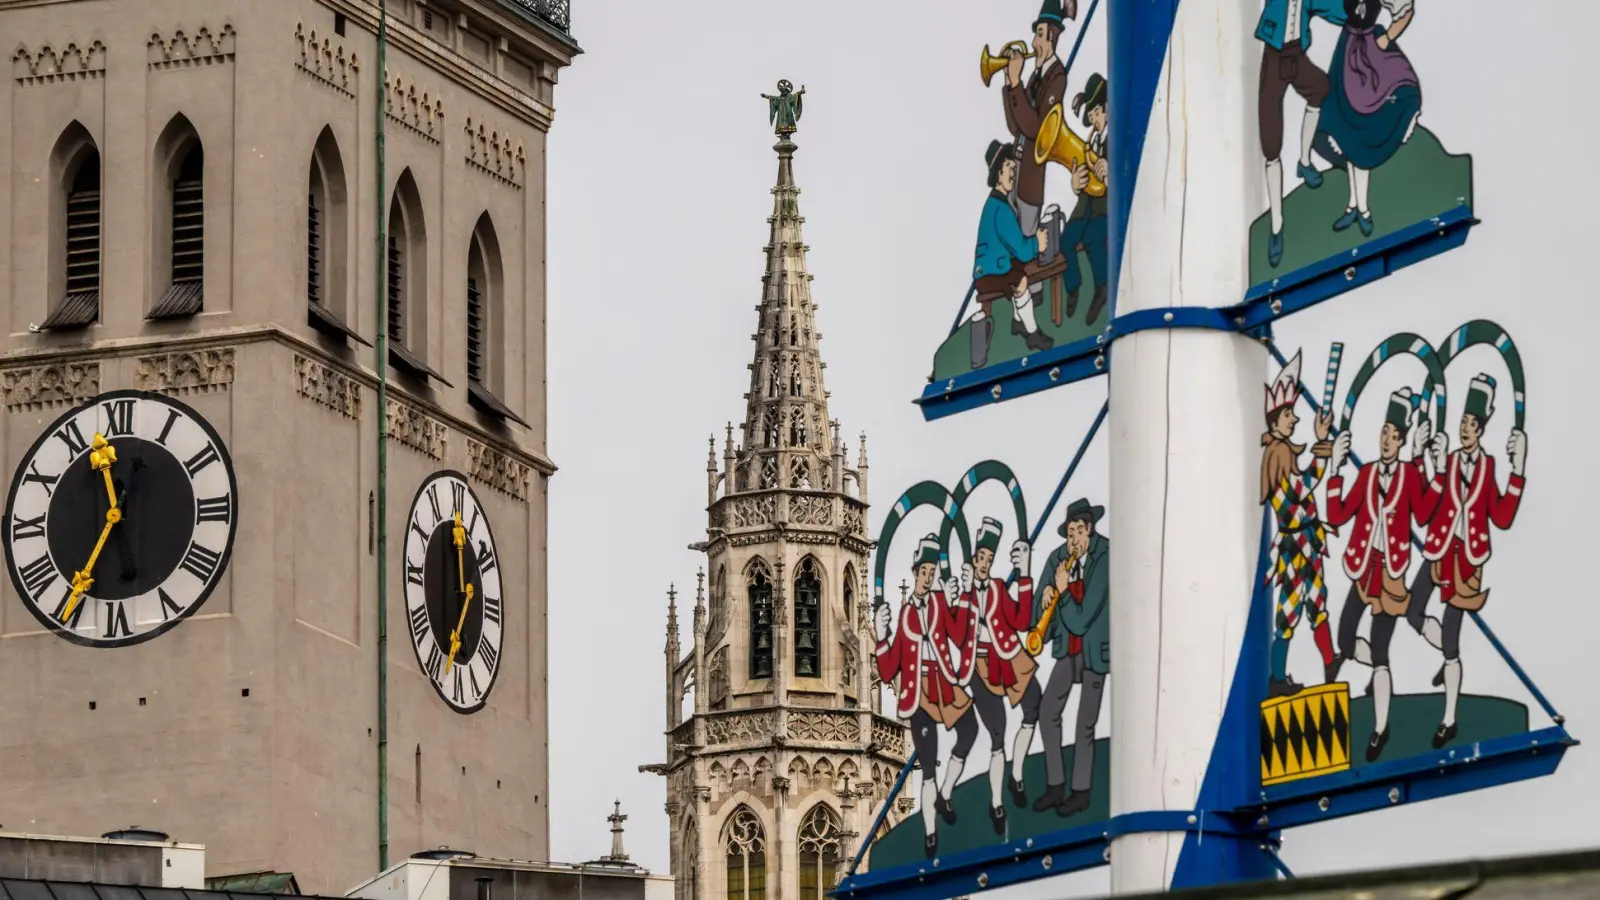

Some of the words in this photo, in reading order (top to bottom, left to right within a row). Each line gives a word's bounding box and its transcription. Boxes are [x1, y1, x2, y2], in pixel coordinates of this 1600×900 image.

[102, 400, 136, 437] XII
[155, 408, 182, 446] I
[53, 418, 89, 462] XI
[22, 460, 60, 497] X
[183, 441, 220, 479] II
[13, 512, 46, 542] IX
[197, 492, 230, 525] III
[18, 551, 59, 602] VIII
[179, 540, 222, 585] IIII
[49, 585, 86, 629] VI
[103, 601, 133, 638] VI
[158, 587, 185, 620] V
